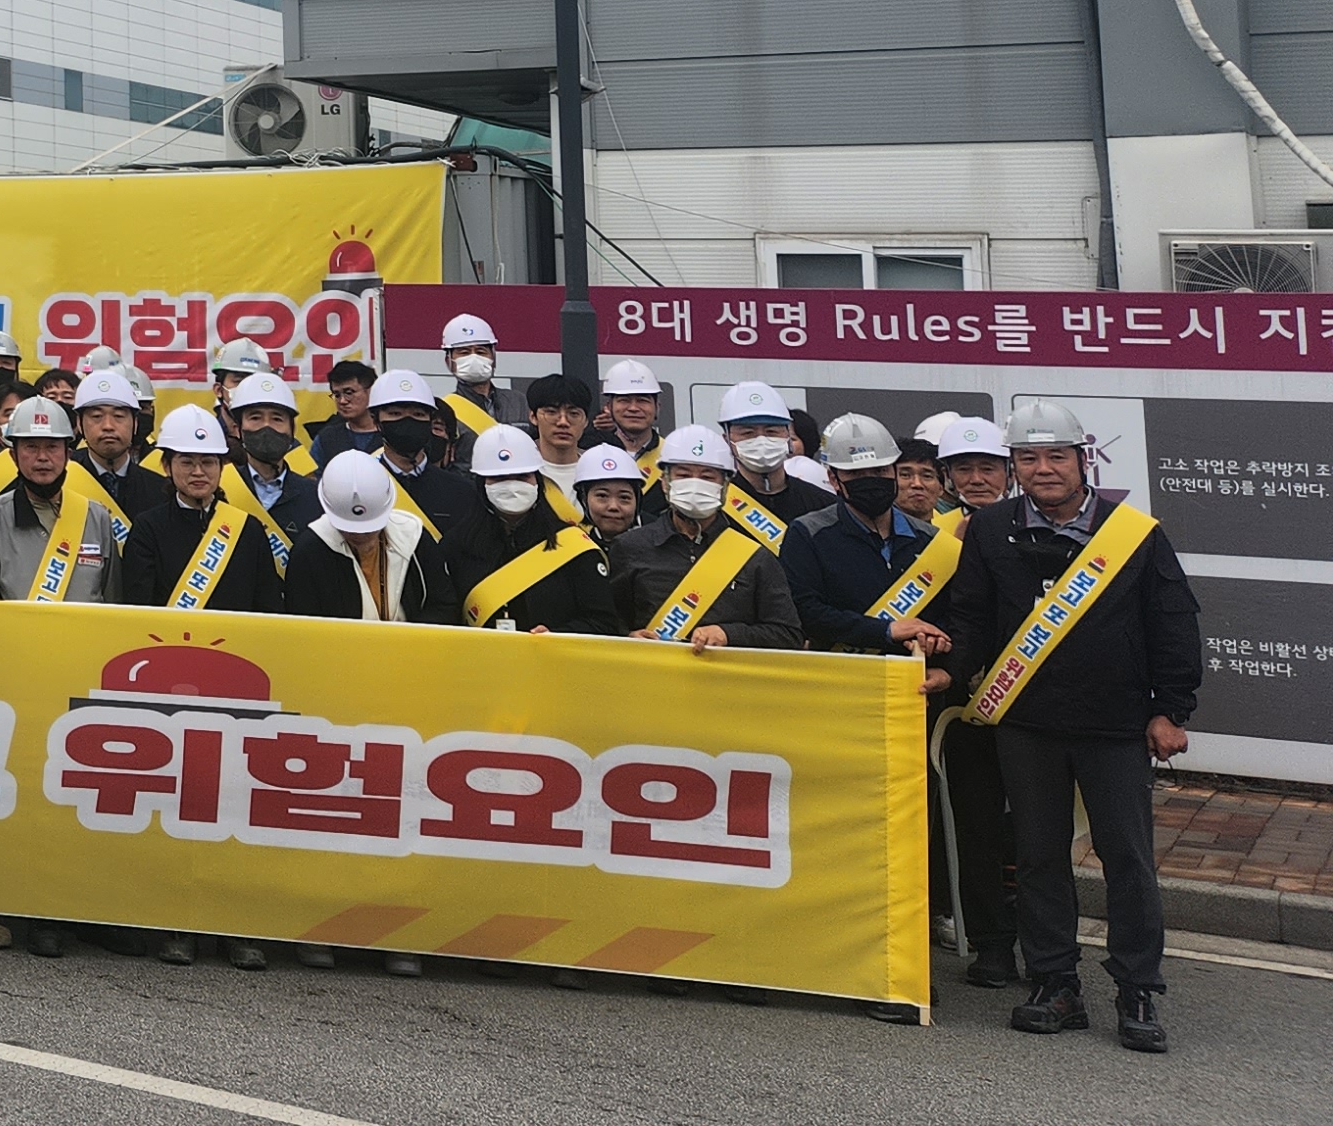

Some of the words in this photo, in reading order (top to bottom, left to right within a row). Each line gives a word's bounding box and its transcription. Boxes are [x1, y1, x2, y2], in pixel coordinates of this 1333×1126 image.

[320, 104, 341, 116] LG
[45, 296, 374, 383] 위험요인
[618, 299, 691, 342] 8대
[716, 301, 808, 347] 생명
[836, 302, 1036, 353] Rules를
[1062, 305, 1226, 354] 반드시
[1158, 457, 1188, 472] 고소
[1194, 459, 1240, 475] 작업은
[1246, 461, 1309, 477] 추락방지
[1315, 463, 1333, 477] 조
[1160, 477, 1213, 493] (안전대
[1217, 479, 1255, 496] 등)를
[1261, 480, 1330, 498] 실시한다.
[198, 535, 229, 572] 보고
[41, 557, 67, 594] 보고
[1058, 568, 1098, 609] 보고
[1042, 603, 1069, 628] 또
[1016, 623, 1052, 661] 보고
[1206, 638, 1254, 655] 작업은
[1259, 641, 1307, 659] 비활선
[1208, 659, 1223, 672] 후
[1229, 660, 1297, 677] 작업한다.
[976, 656, 1025, 720] 위험요인
[61, 723, 772, 870] 위험요인
